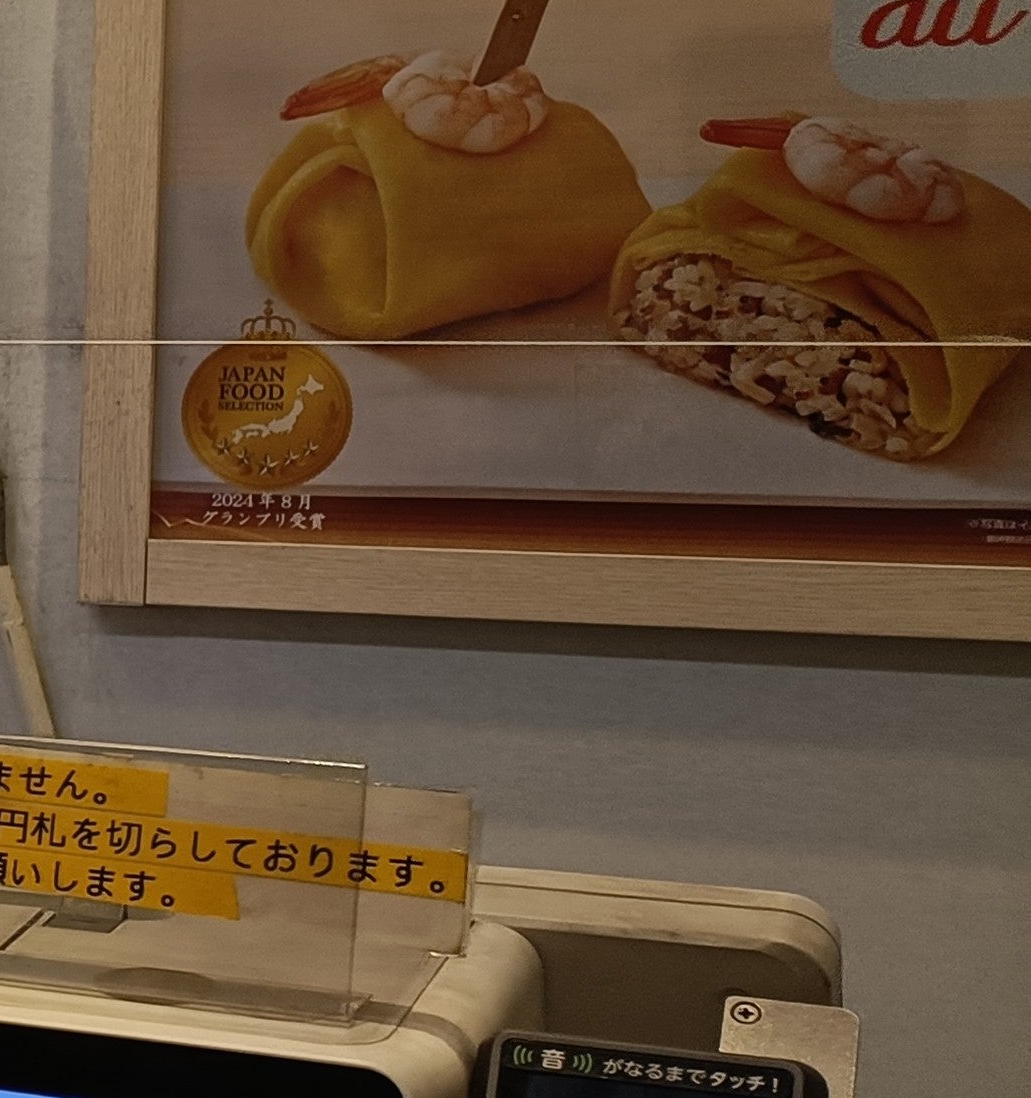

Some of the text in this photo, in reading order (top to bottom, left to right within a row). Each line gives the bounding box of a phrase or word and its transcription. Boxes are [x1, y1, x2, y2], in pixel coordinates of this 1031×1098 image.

[859, 0, 1030, 50] au
[219, 366, 286, 383] JAPAN
[219, 383, 285, 401] FOOD
[218, 401, 284, 412] SELECTION
[201, 510, 326, 531] グランプリ受賞
[540, 1048, 567, 1070] 音
